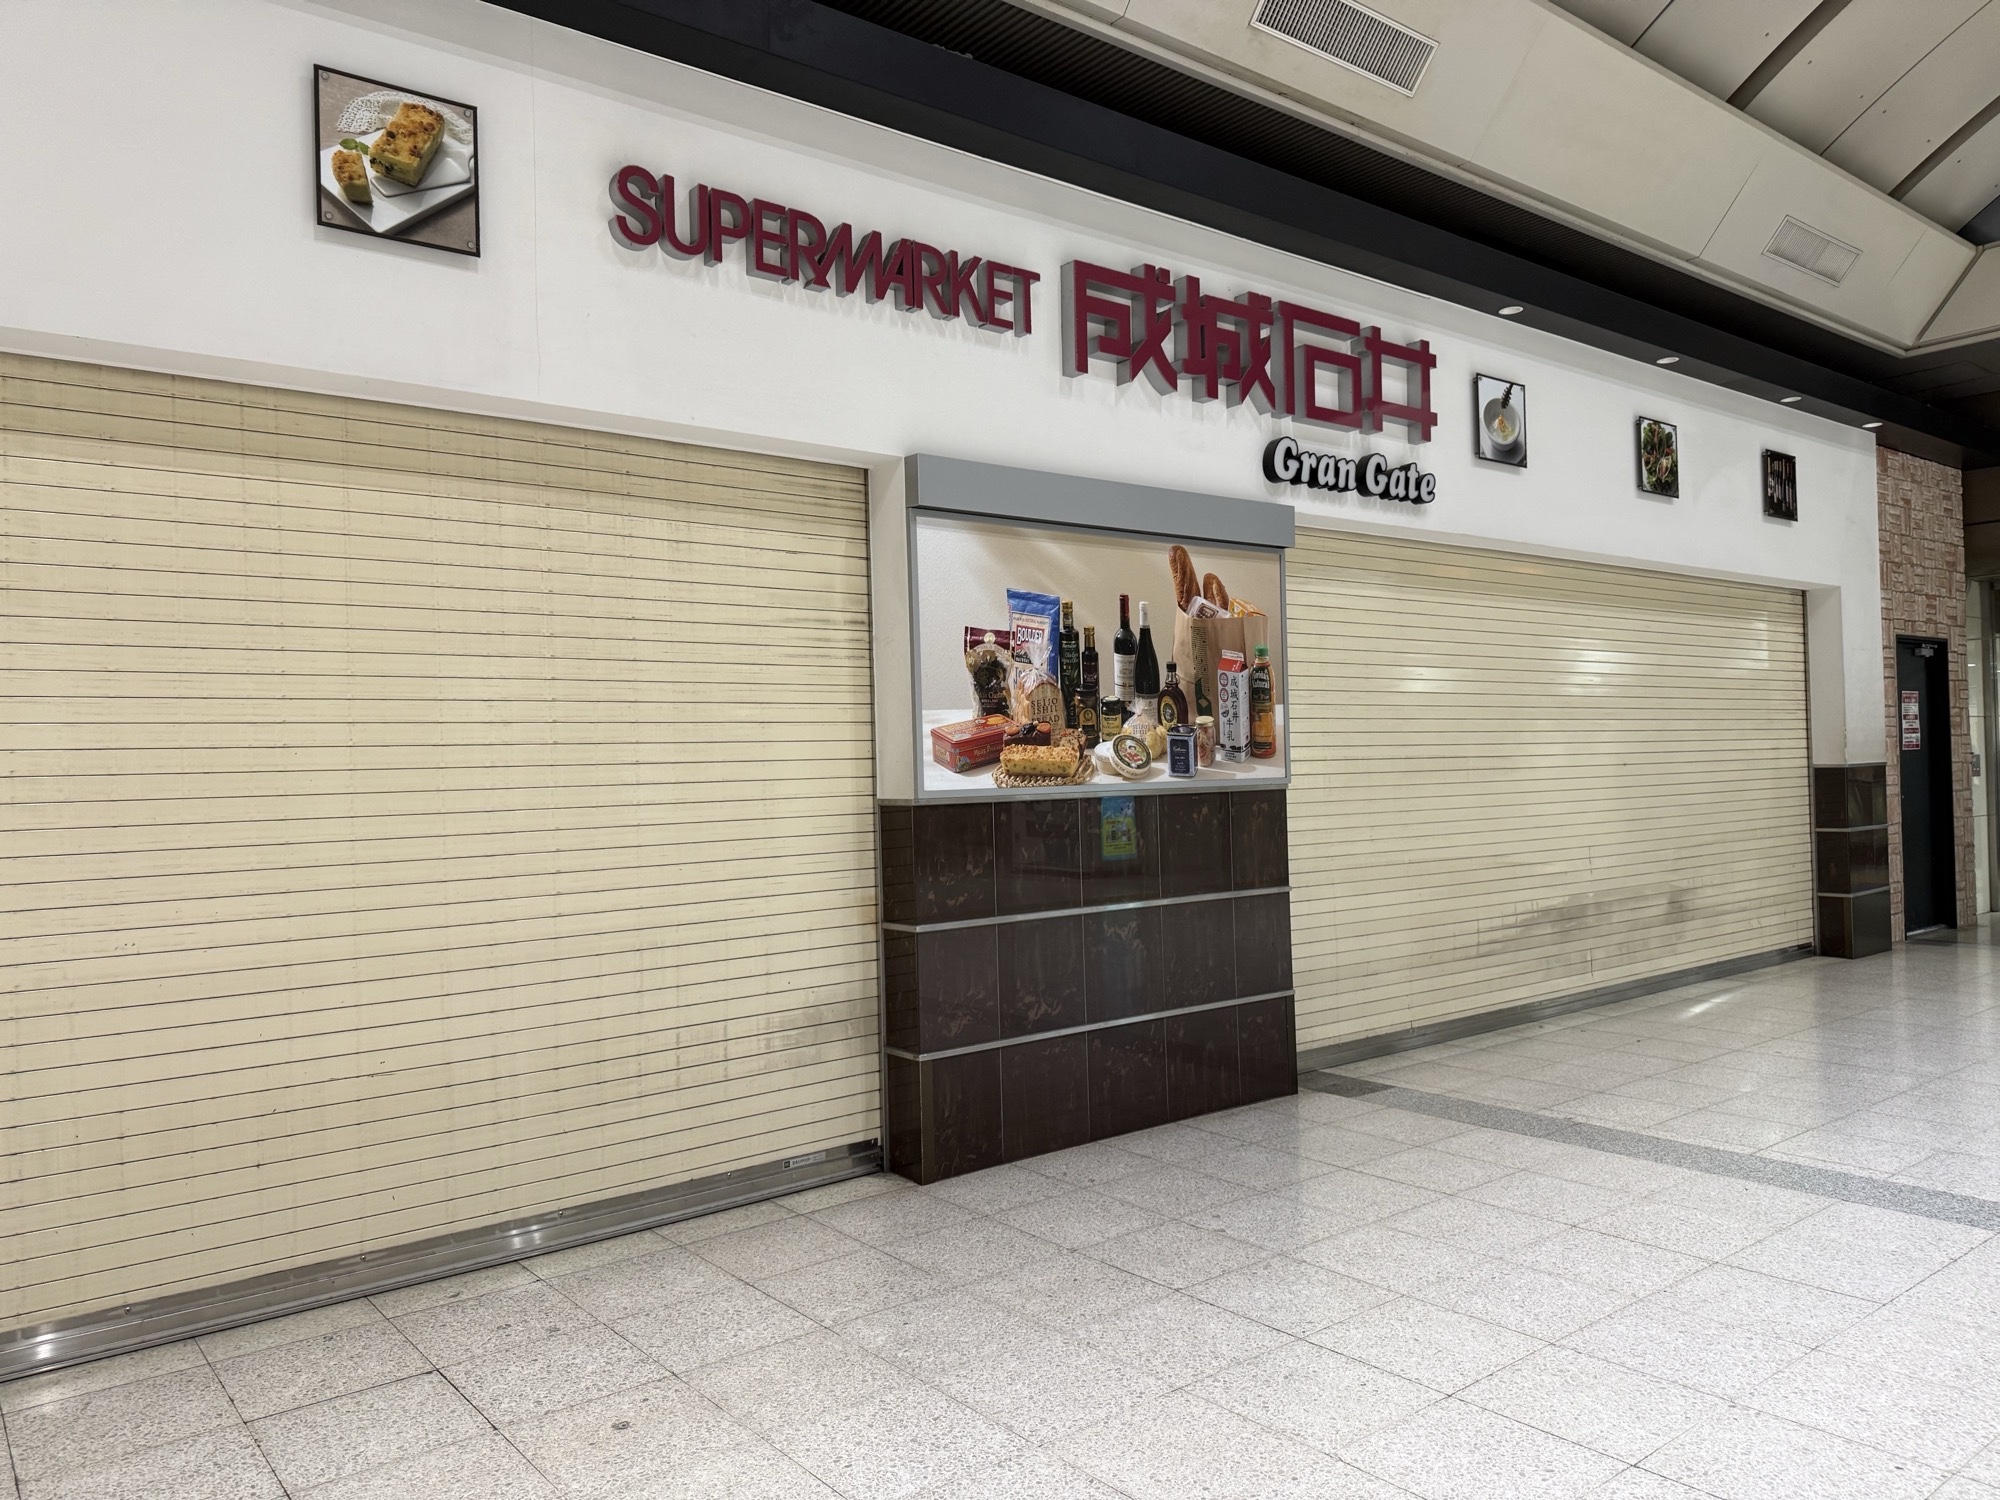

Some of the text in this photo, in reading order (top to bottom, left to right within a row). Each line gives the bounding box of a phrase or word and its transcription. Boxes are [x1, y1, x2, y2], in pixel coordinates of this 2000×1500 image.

[609, 165, 1040, 338] SUPERMARKET
[1061, 259, 1438, 444] 成城石井
[1264, 436, 1436, 504] Gran Gate
[1031, 698, 1058, 708] SEIJO
[1033, 705, 1058, 715] ISHII
